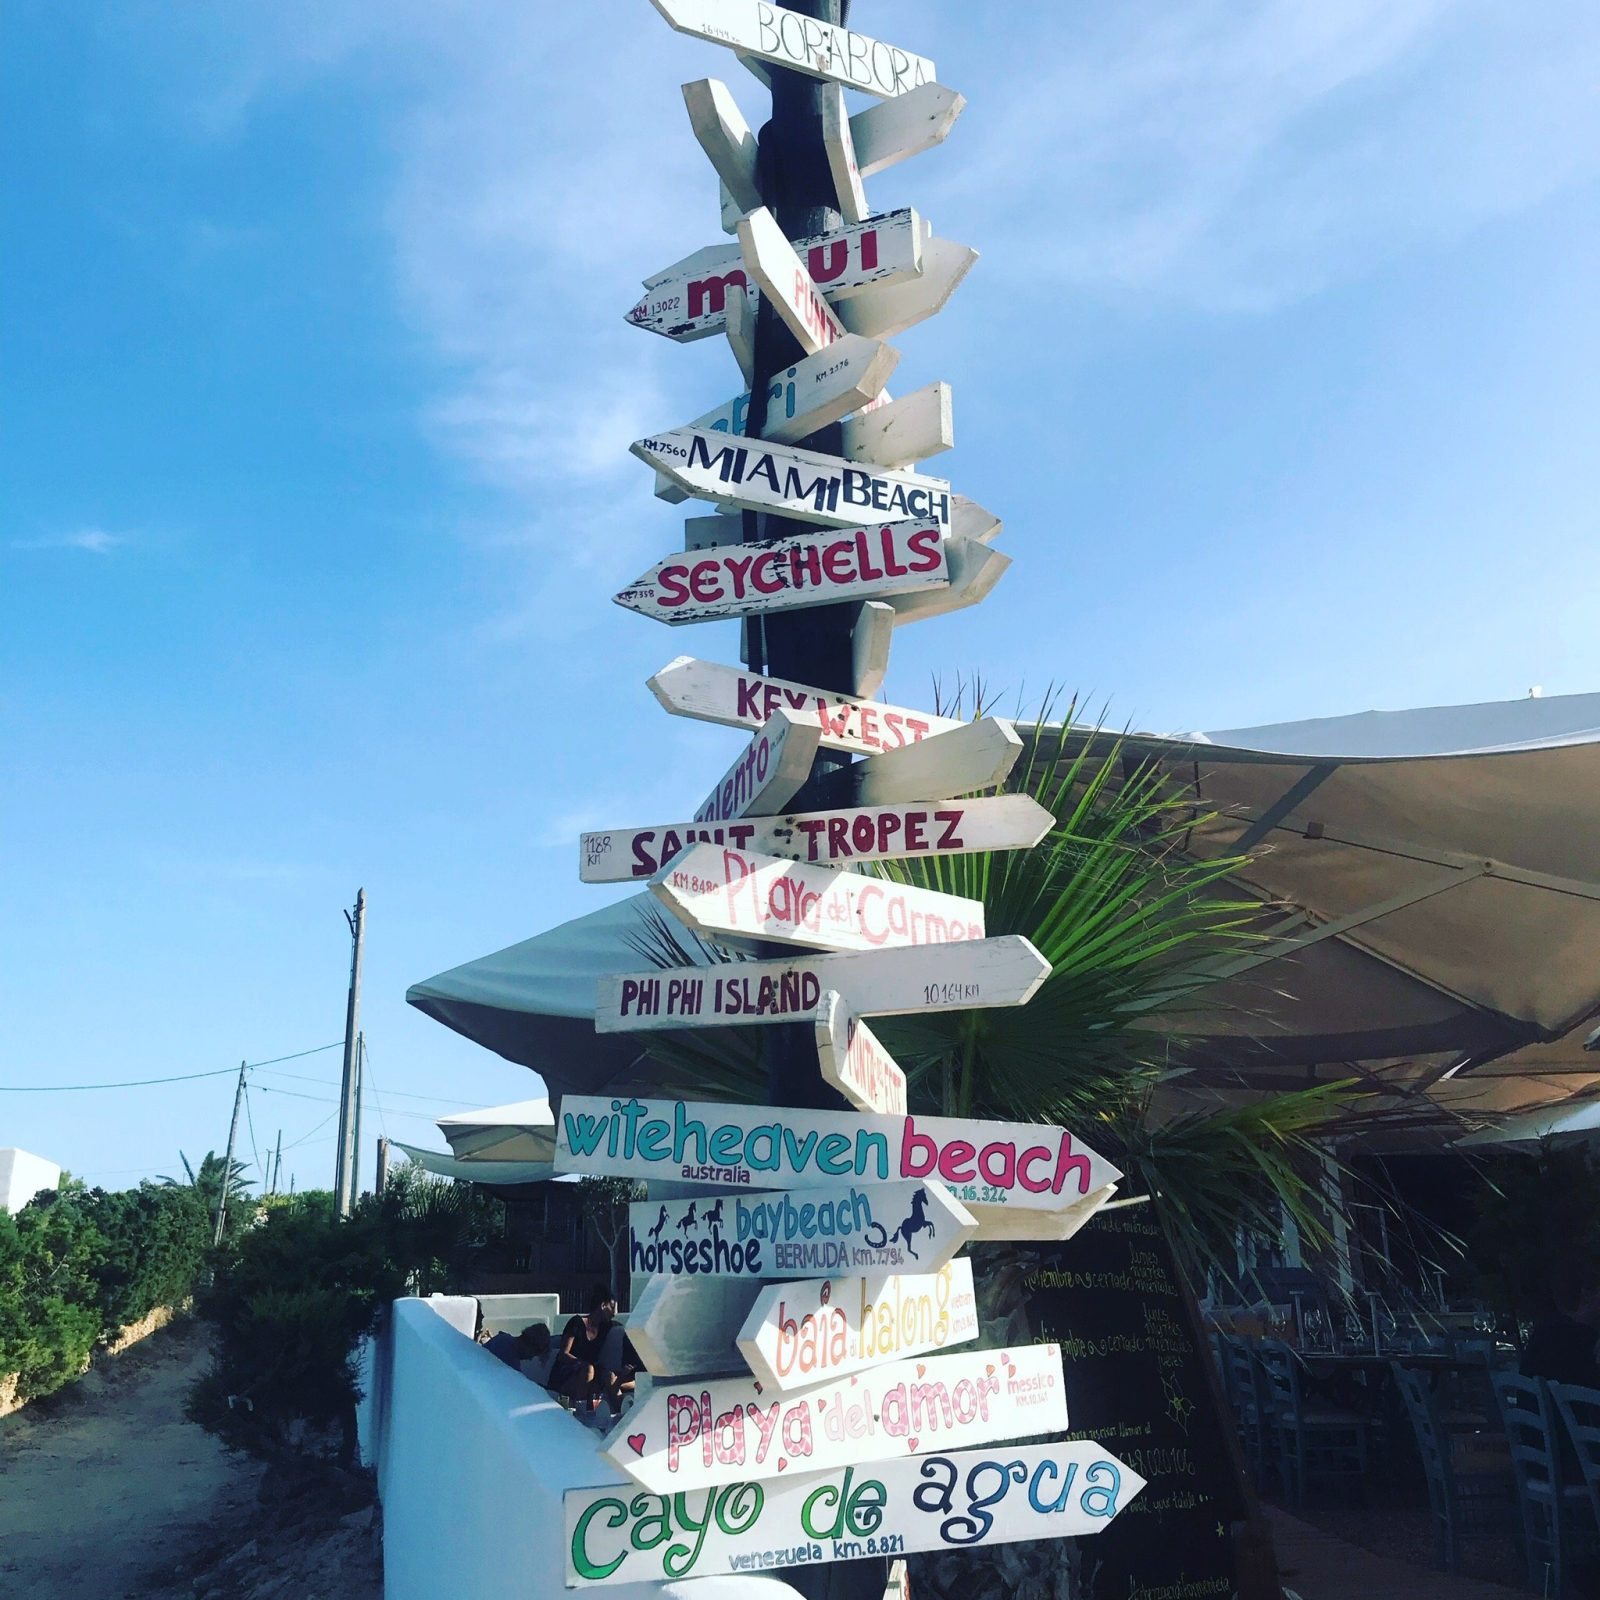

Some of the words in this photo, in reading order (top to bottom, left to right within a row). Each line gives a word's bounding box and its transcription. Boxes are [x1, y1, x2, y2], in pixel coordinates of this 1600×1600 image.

[687, 434, 841, 512] MIAMI
[842, 468, 948, 524] BEACH
[657, 529, 940, 607] SEYCHELLS
[797, 810, 965, 862] TROPEZ
[620, 979, 660, 1016] PHI
[667, 979, 703, 1015] PHI
[714, 970, 820, 1015] ISLAND
[681, 1163, 750, 1185] australia
[900, 1115, 1091, 1195] beach
[630, 1223, 762, 1275] horseshoe
[774, 1242, 850, 1270] BERMUDA
[666, 1390, 815, 1474] Playa
[822, 1388, 876, 1443] del
[880, 1376, 1001, 1438] amor
[800, 1466, 887, 1540] de
[912, 1456, 1120, 1544] agua
[728, 1543, 822, 1572] venezuela
[832, 1534, 905, 1558] km.8.821
